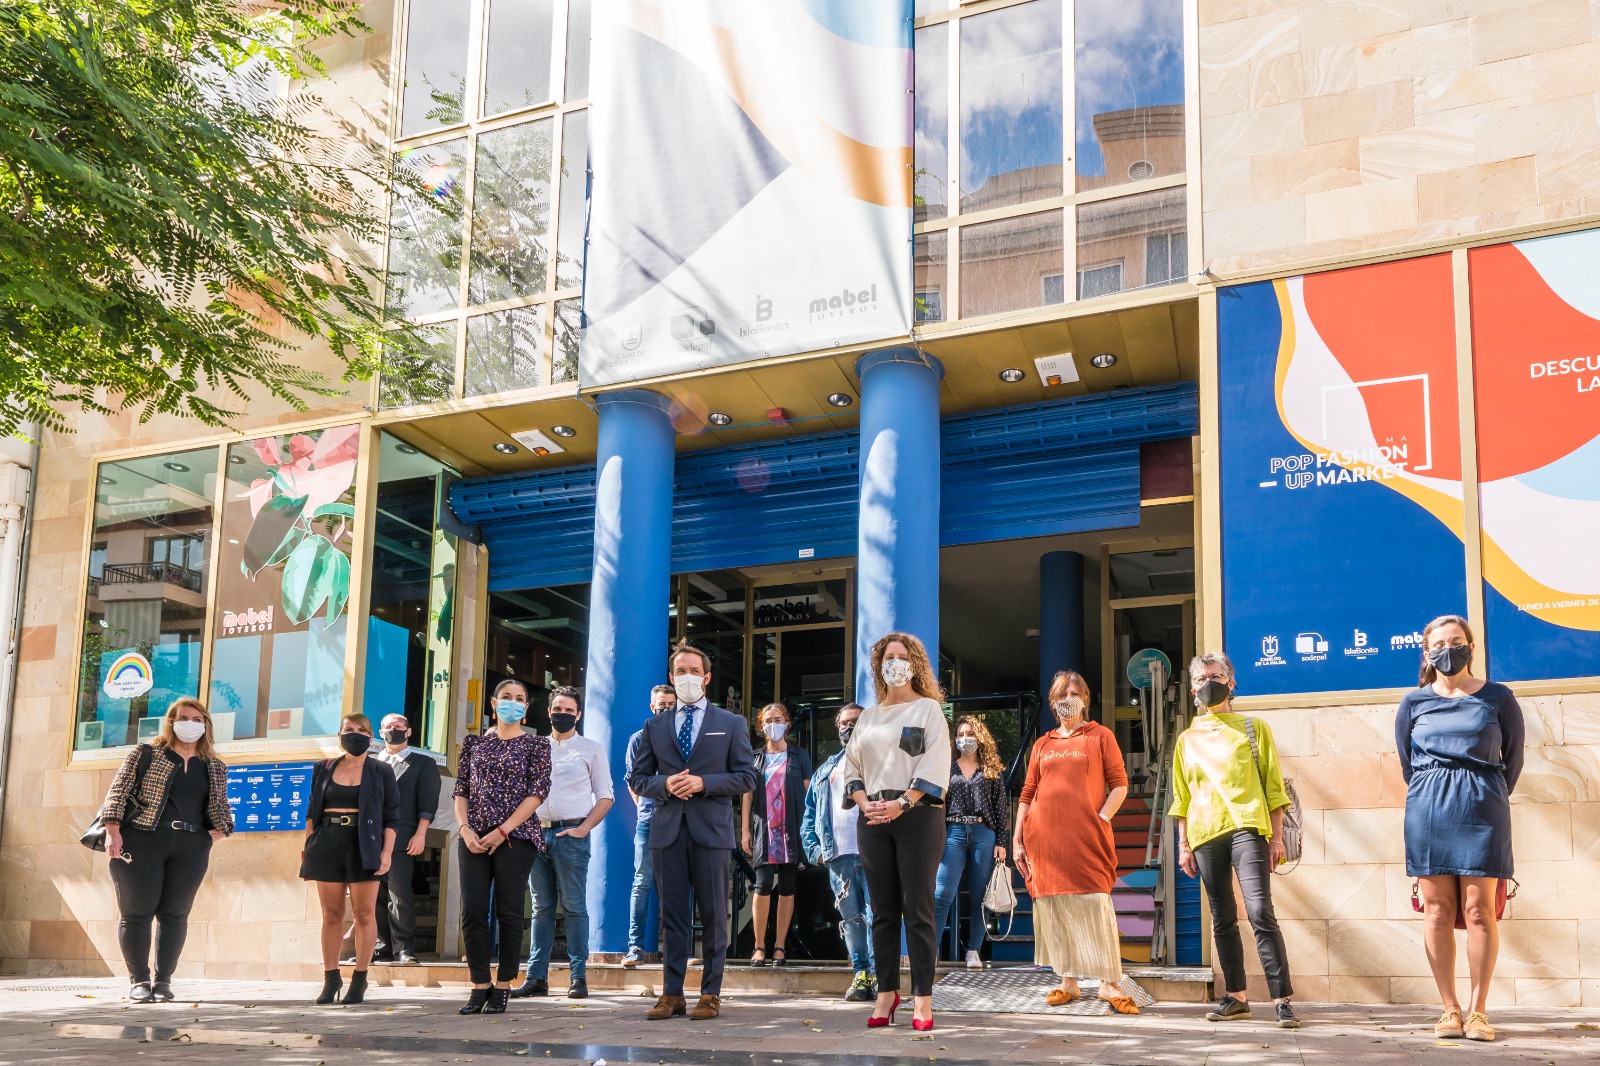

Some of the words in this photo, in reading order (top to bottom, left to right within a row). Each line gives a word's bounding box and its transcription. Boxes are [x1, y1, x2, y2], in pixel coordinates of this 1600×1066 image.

[809, 283, 877, 313] mabel
[809, 303, 877, 323] JOYEROS
[739, 321, 789, 338] IslaBonita
[1530, 355, 1600, 378] DESCU
[1270, 454, 1314, 474] POP
[1316, 443, 1408, 469] FASHION
[1285, 471, 1314, 489] UP
[1316, 462, 1408, 487] MARKET
[1517, 602, 1543, 611] LUNES
[1552, 599, 1586, 609] VIERNES
[1588, 598, 1600, 606] DE
[223, 605, 274, 628] mabel
[758, 613, 810, 624] JOYEROS
[222, 623, 273, 637] JOYEROS
[1301, 654, 1327, 662] sodepal
[1344, 647, 1379, 655] IslaBonita
